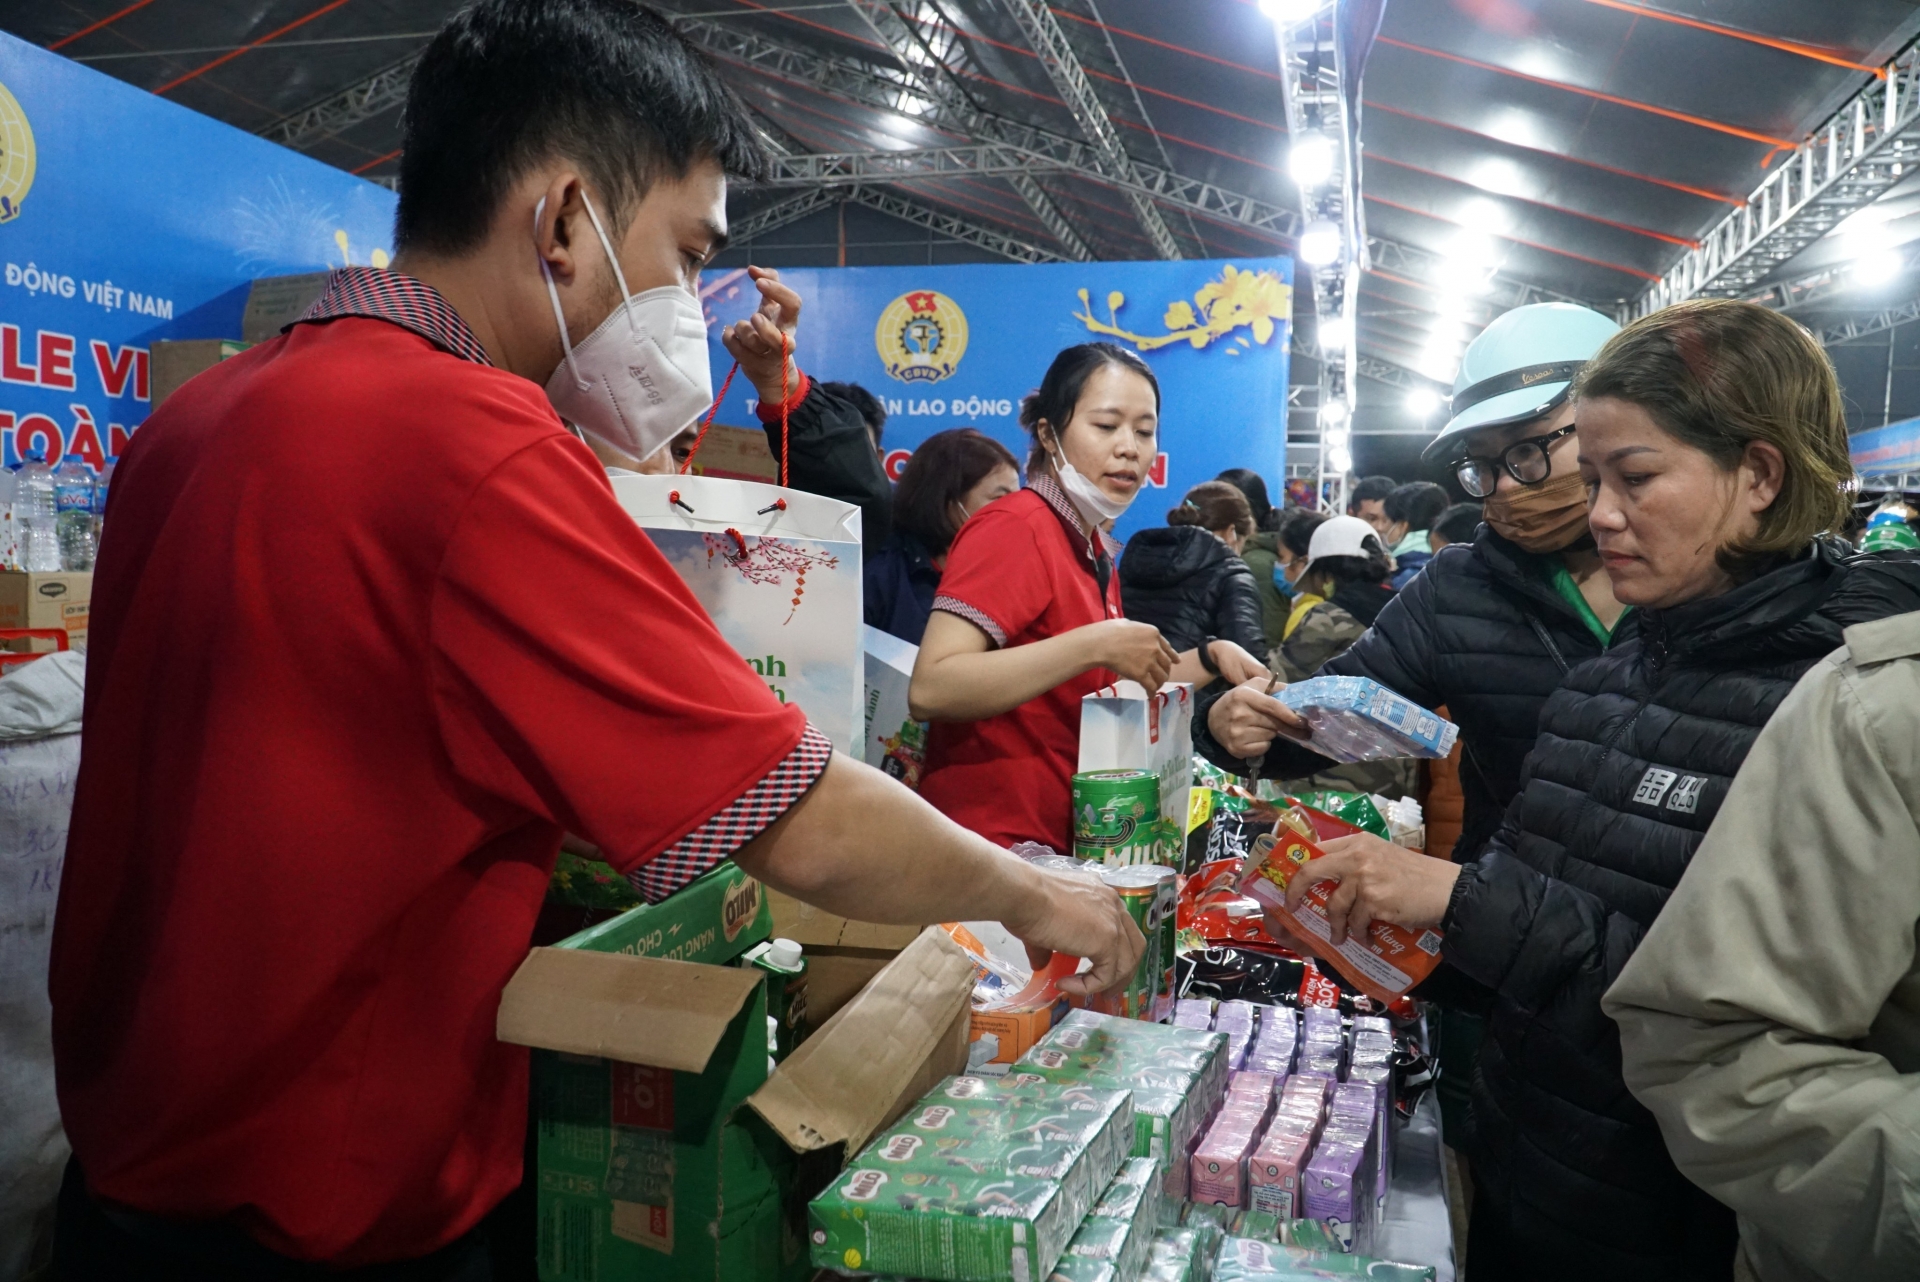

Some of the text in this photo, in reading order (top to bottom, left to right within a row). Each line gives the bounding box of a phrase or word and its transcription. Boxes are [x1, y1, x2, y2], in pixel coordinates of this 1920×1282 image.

[5, 262, 173, 320] ĐỘNG VIỆT NAM
[908, 399, 946, 415] LAO
[951, 395, 1012, 420] ĐỘNG
[725, 880, 757, 926] MILO
[686, 926, 715, 958] NĂNG
[922, 1107, 950, 1127] MILO
[888, 1136, 917, 1160] MILO
[850, 1172, 882, 1198] MILO
